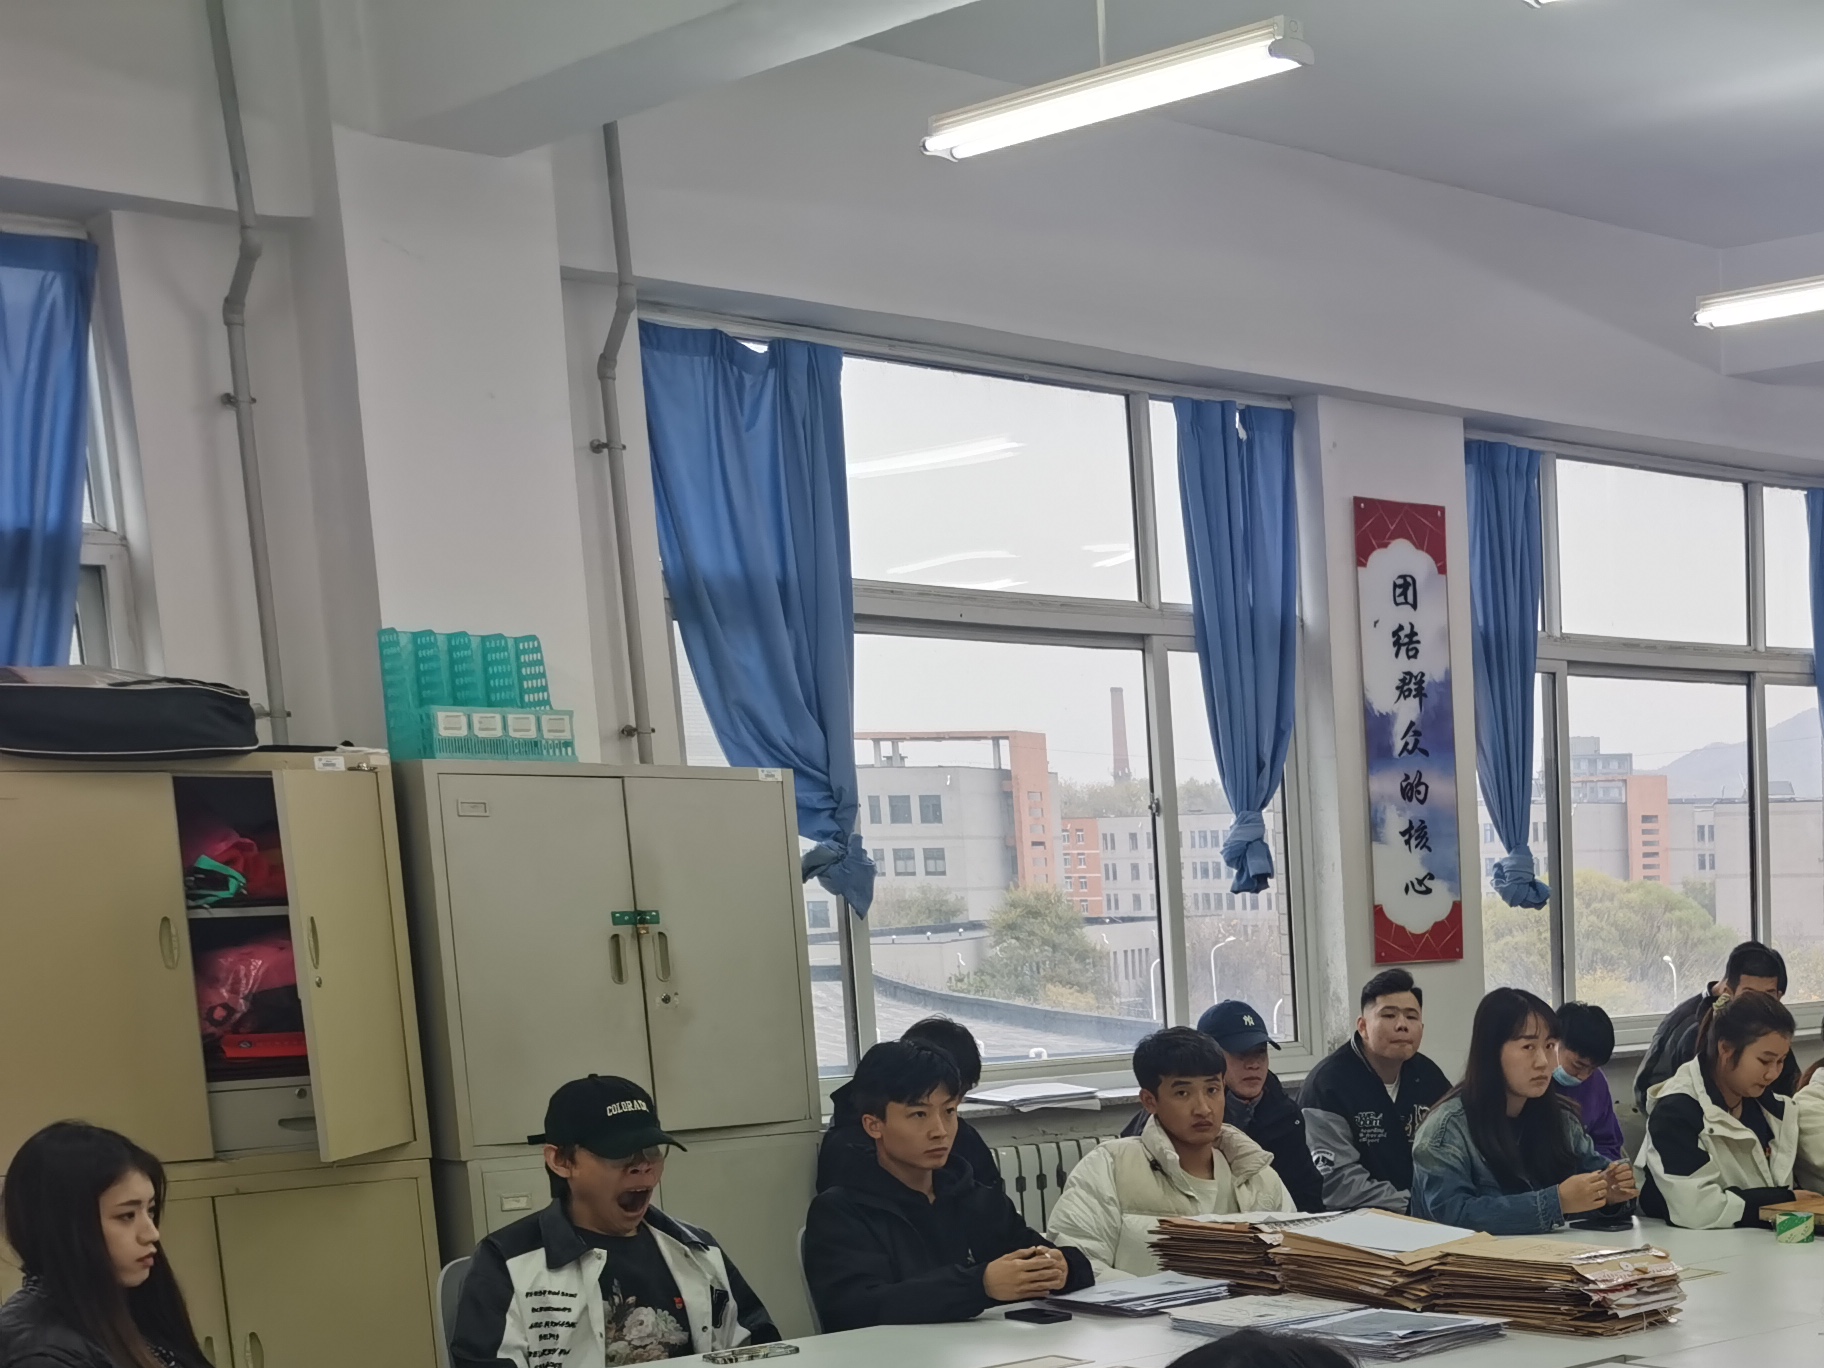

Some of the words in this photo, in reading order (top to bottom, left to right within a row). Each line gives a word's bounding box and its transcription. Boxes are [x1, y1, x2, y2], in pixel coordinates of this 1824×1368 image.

[1392, 574, 1434, 896] 团结群众的核心
[606, 1100, 649, 1117] COLORAD
